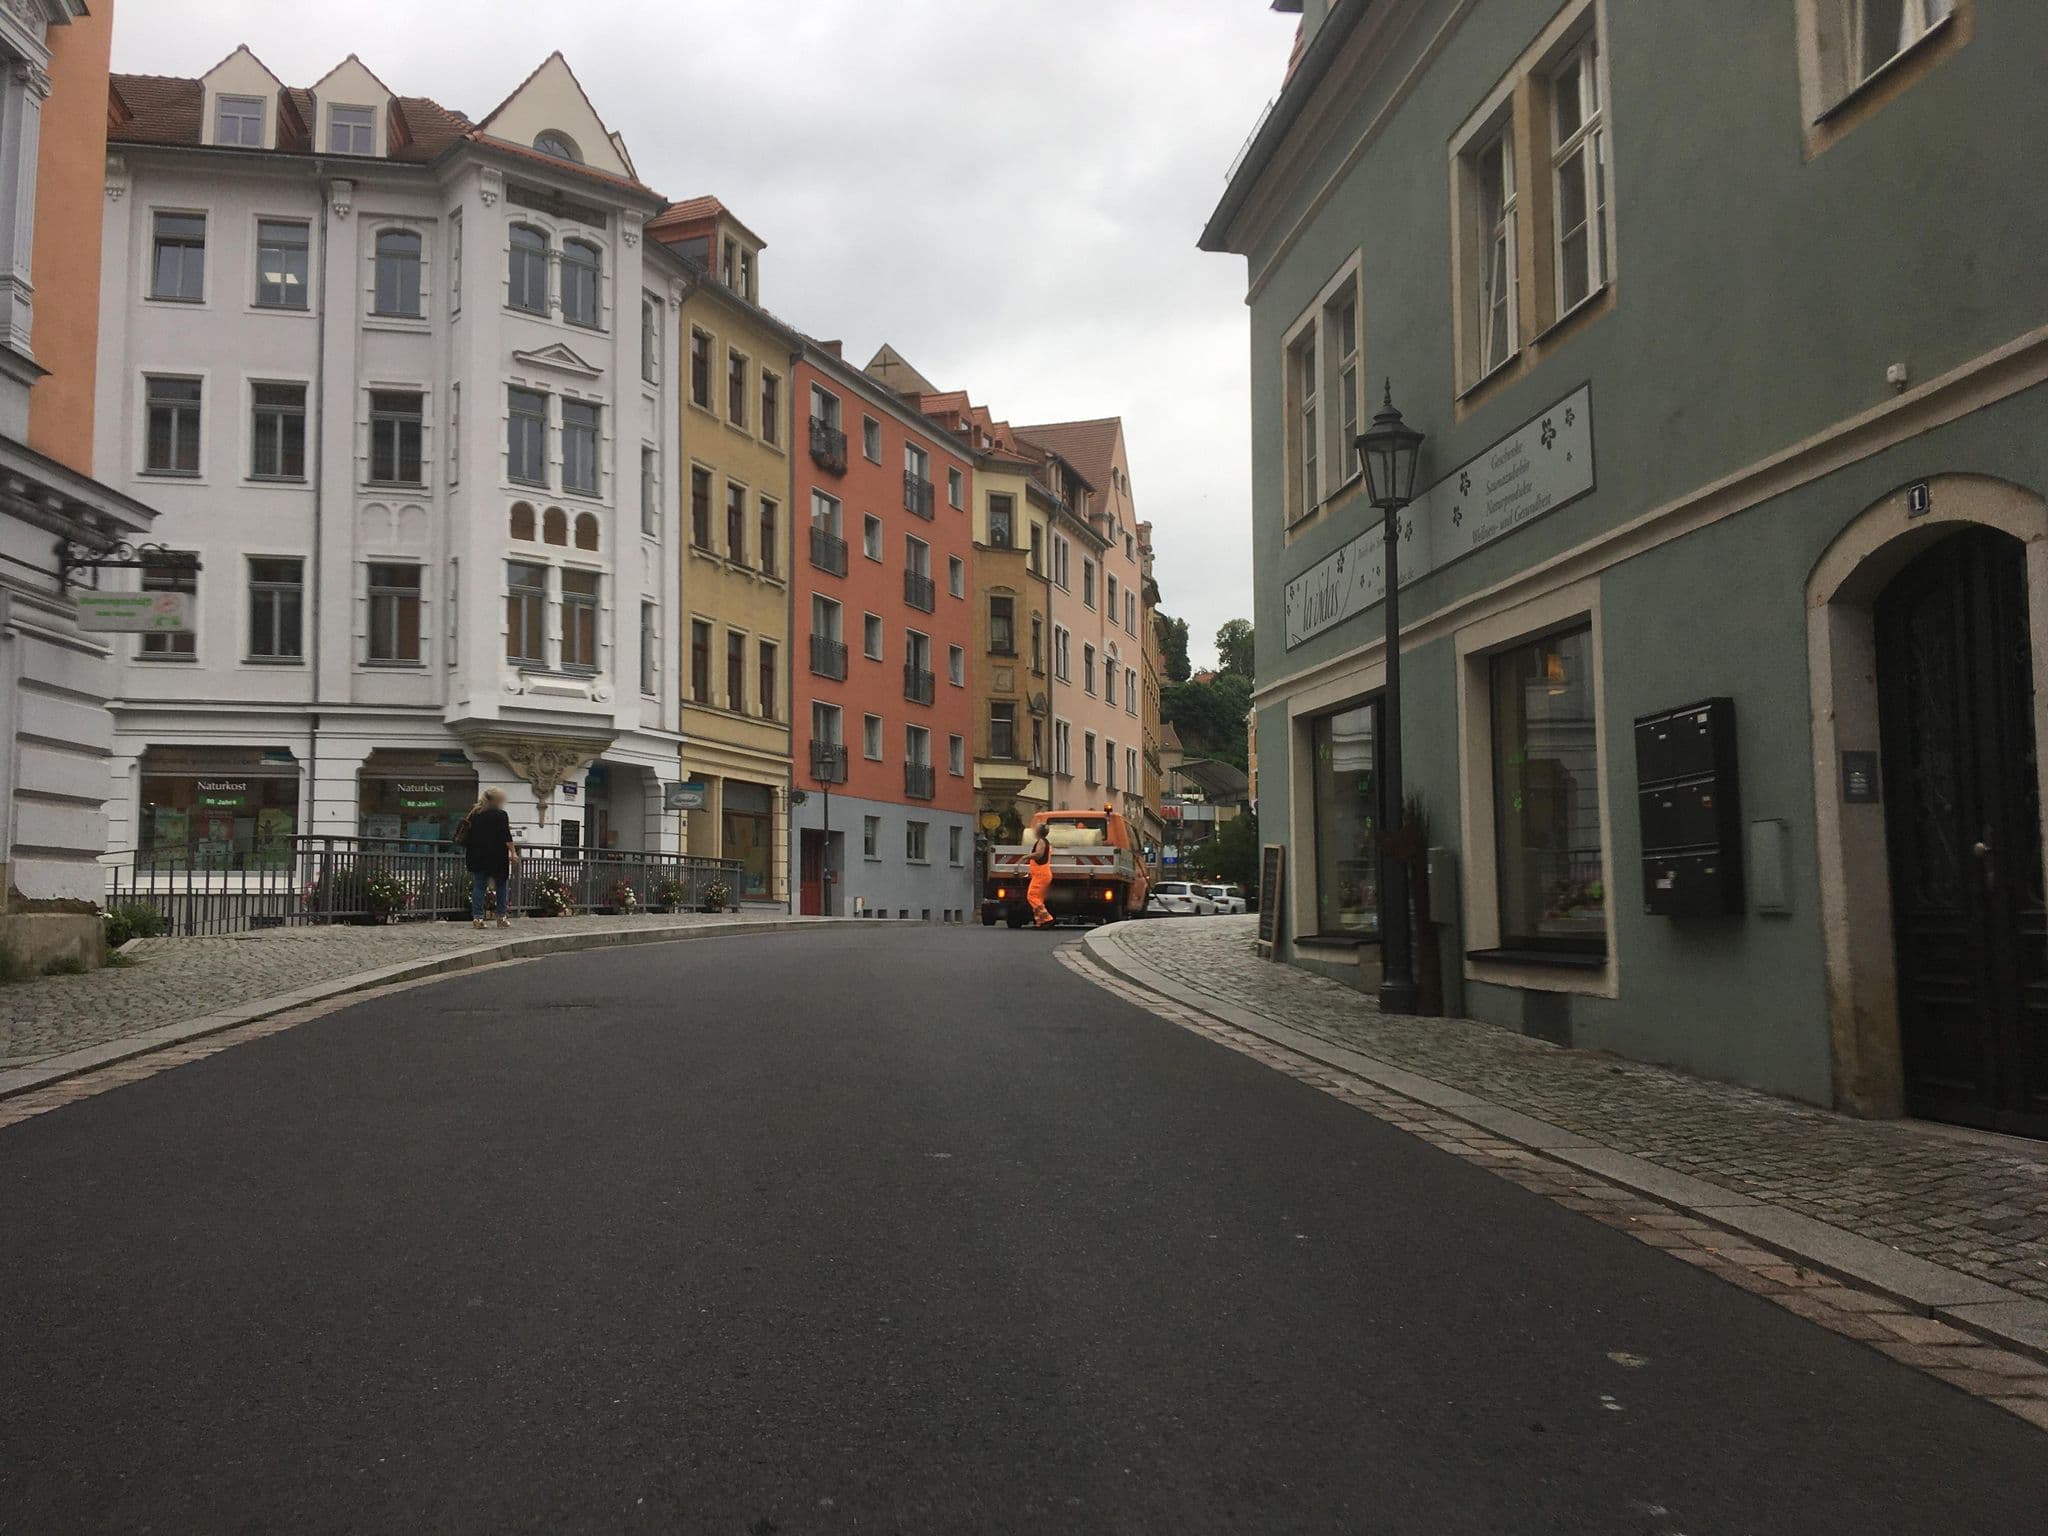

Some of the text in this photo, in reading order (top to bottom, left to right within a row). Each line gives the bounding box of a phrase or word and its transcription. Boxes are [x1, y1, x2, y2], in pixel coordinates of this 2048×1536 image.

[1913, 488, 1922, 511] 1
[197, 781, 247, 791] Naturkost
[397, 783, 445, 793] Naturkost
